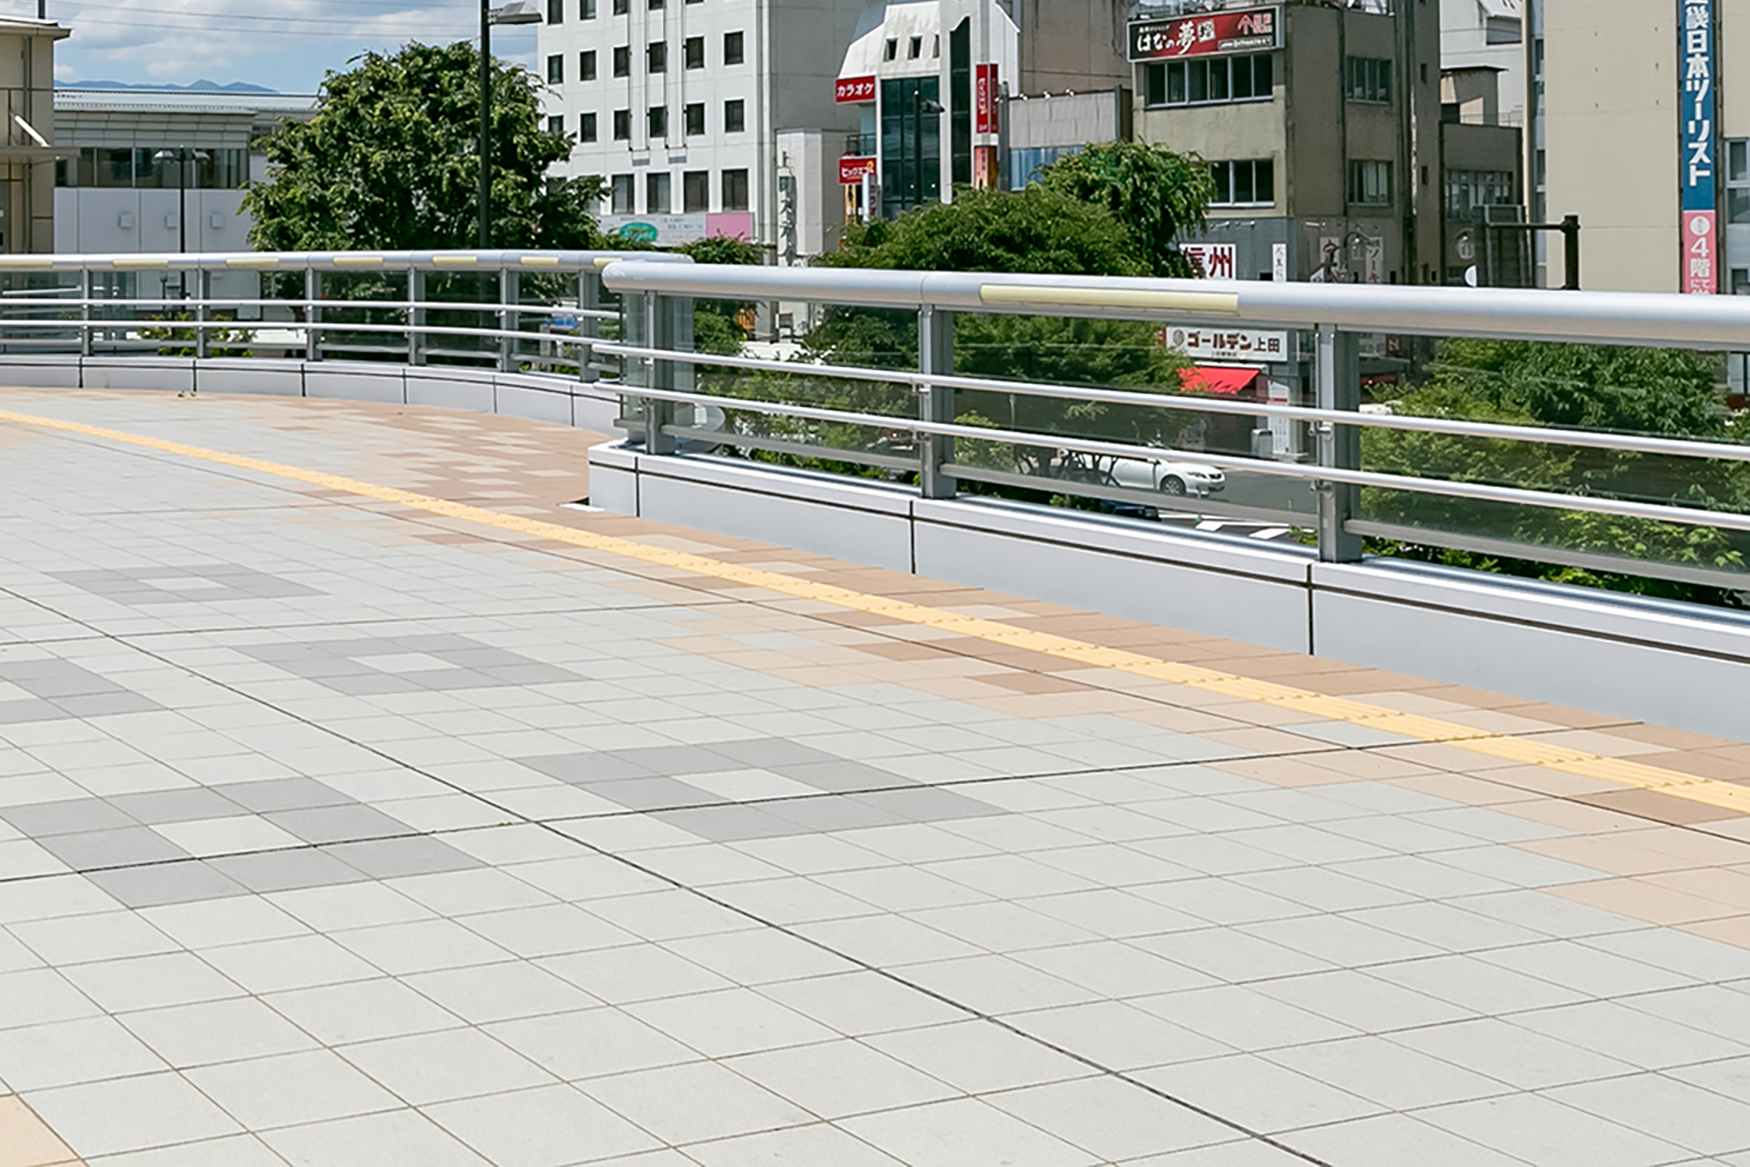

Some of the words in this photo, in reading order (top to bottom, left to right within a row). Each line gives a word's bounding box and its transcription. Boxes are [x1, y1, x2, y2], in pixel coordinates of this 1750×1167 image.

[1137, 20, 1196, 55] はなの夢
[837, 83, 874, 98] カラオケ
[1187, 330, 1280, 353] ゴールデン上田
